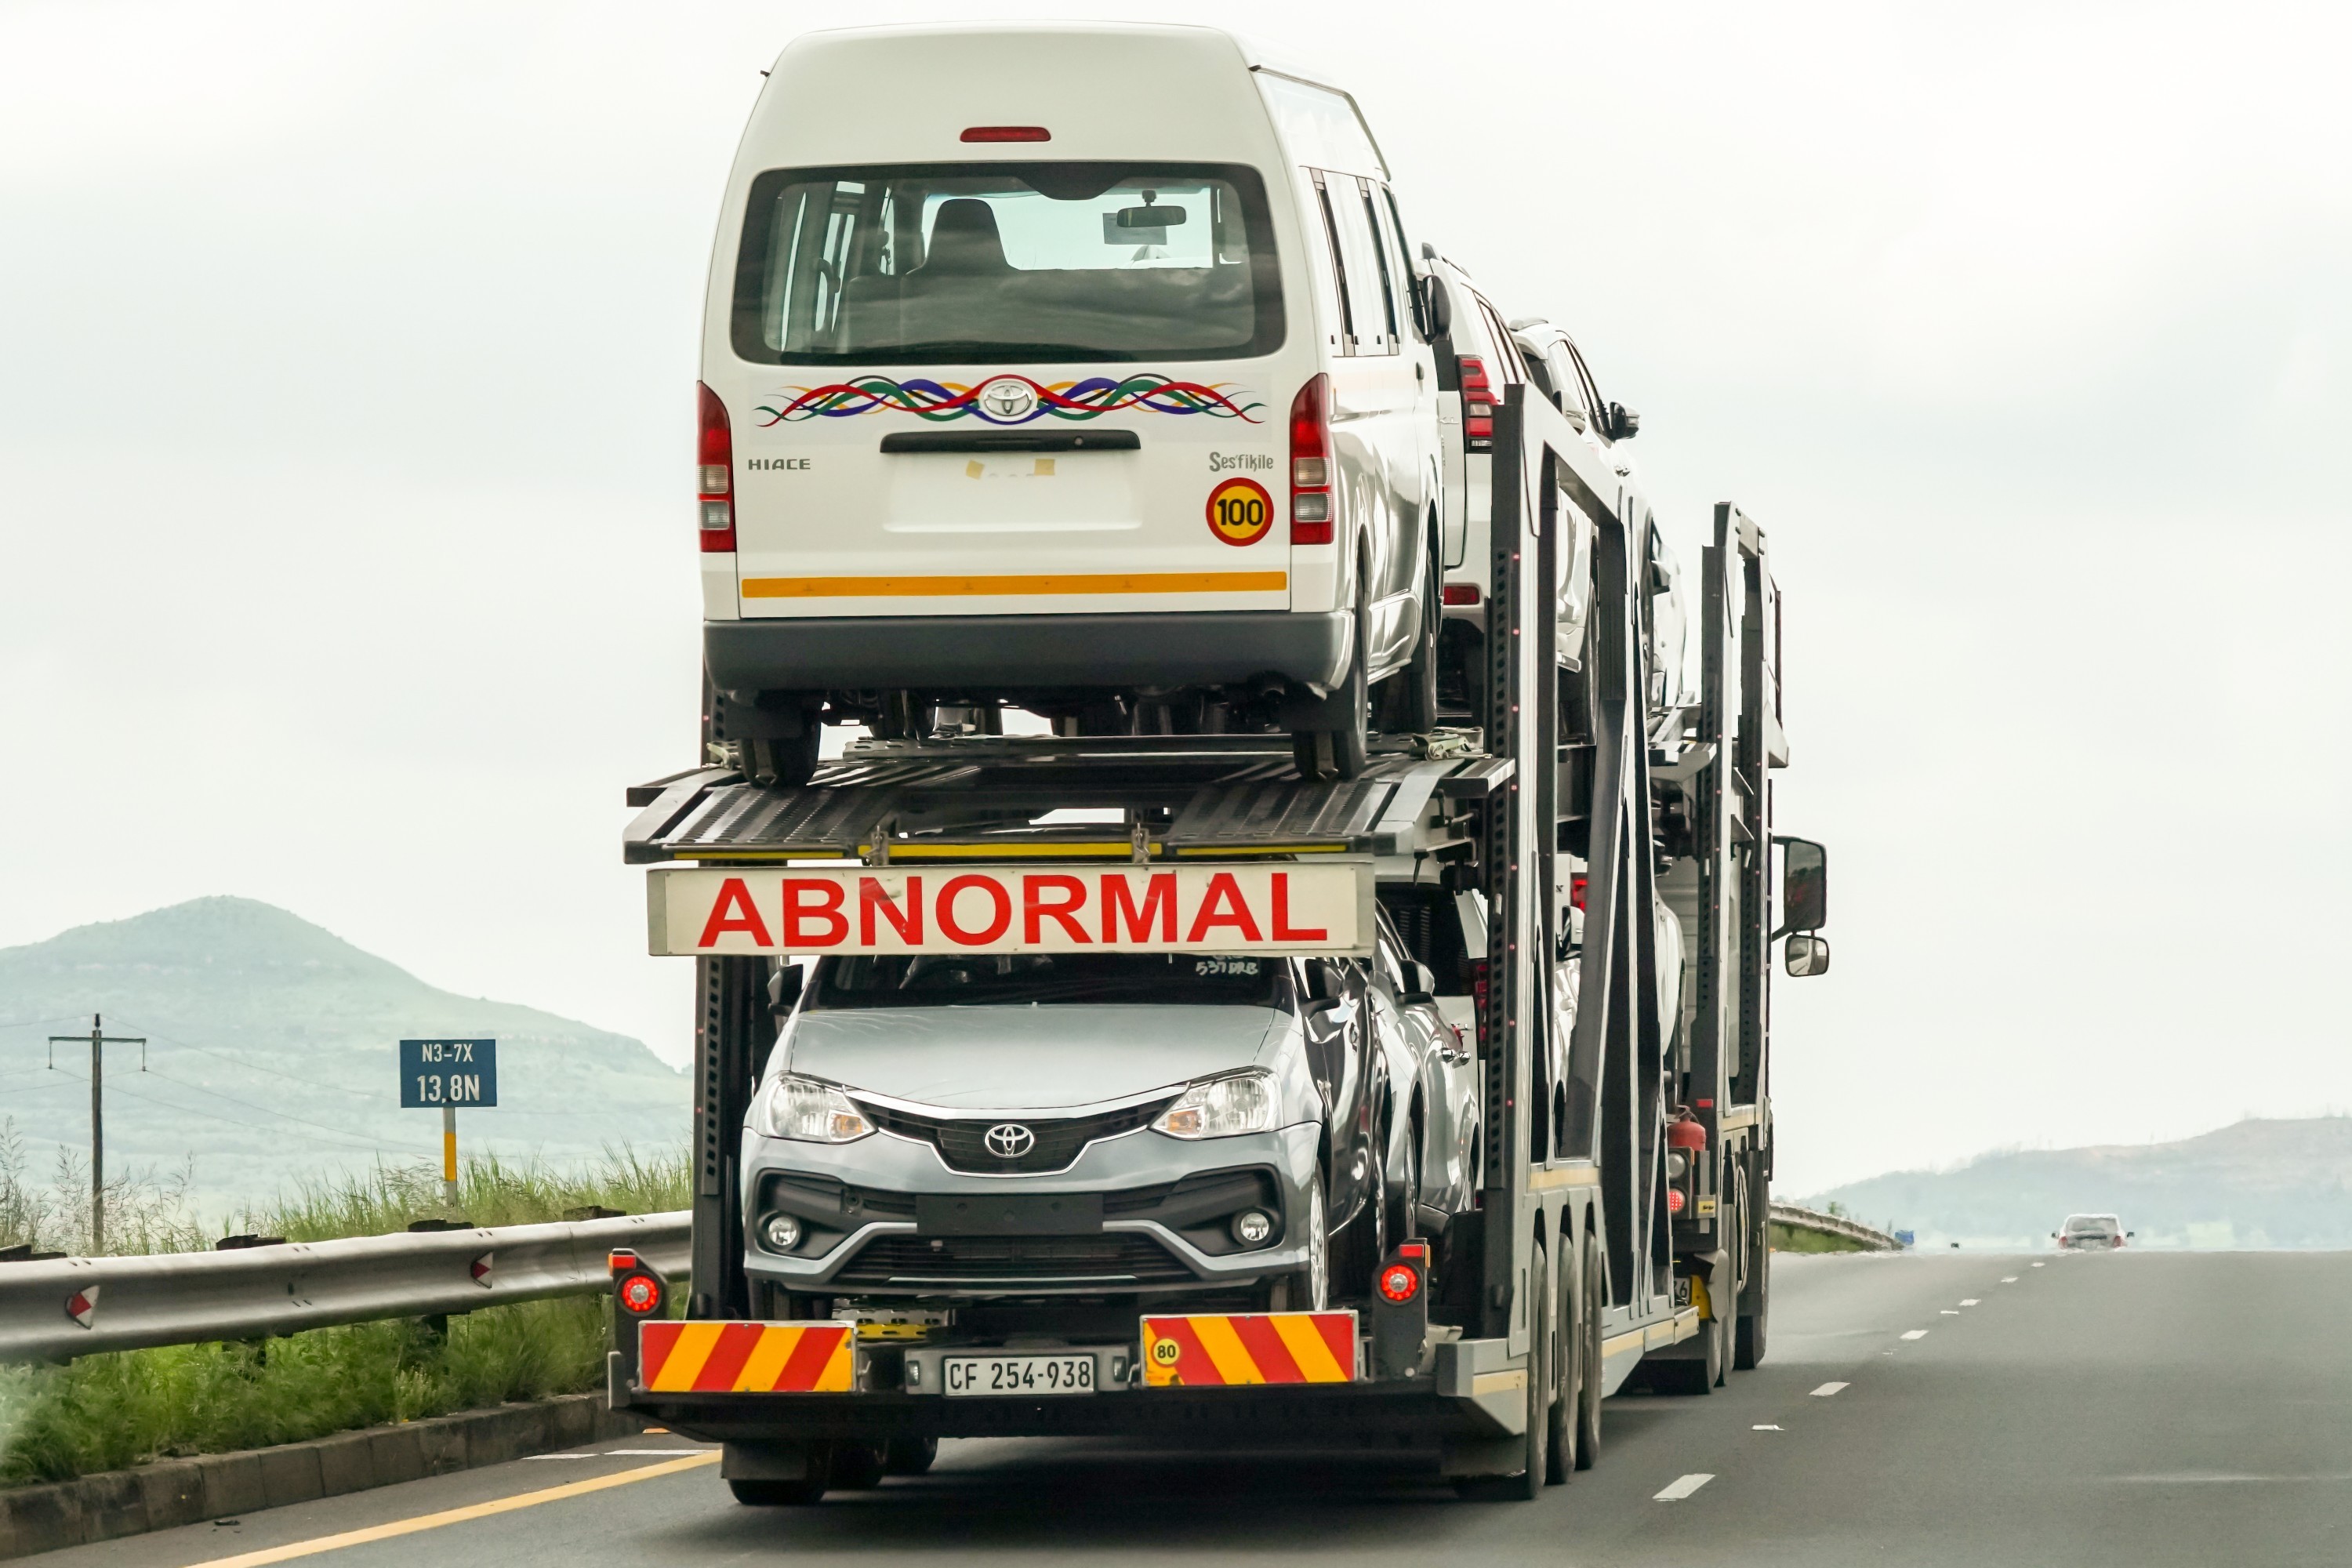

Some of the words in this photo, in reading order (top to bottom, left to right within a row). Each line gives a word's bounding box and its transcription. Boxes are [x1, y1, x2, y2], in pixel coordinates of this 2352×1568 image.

[748, 459, 811, 470] HIACE
[1217, 499, 1264, 526] 100
[698, 873, 1327, 947] ABNORMAL
[422, 1044, 474, 1062] N3-7X
[1157, 1345, 1176, 1359] 80
[950, 1363, 978, 1390] CF
[991, 1361, 1091, 1389] 254-938
